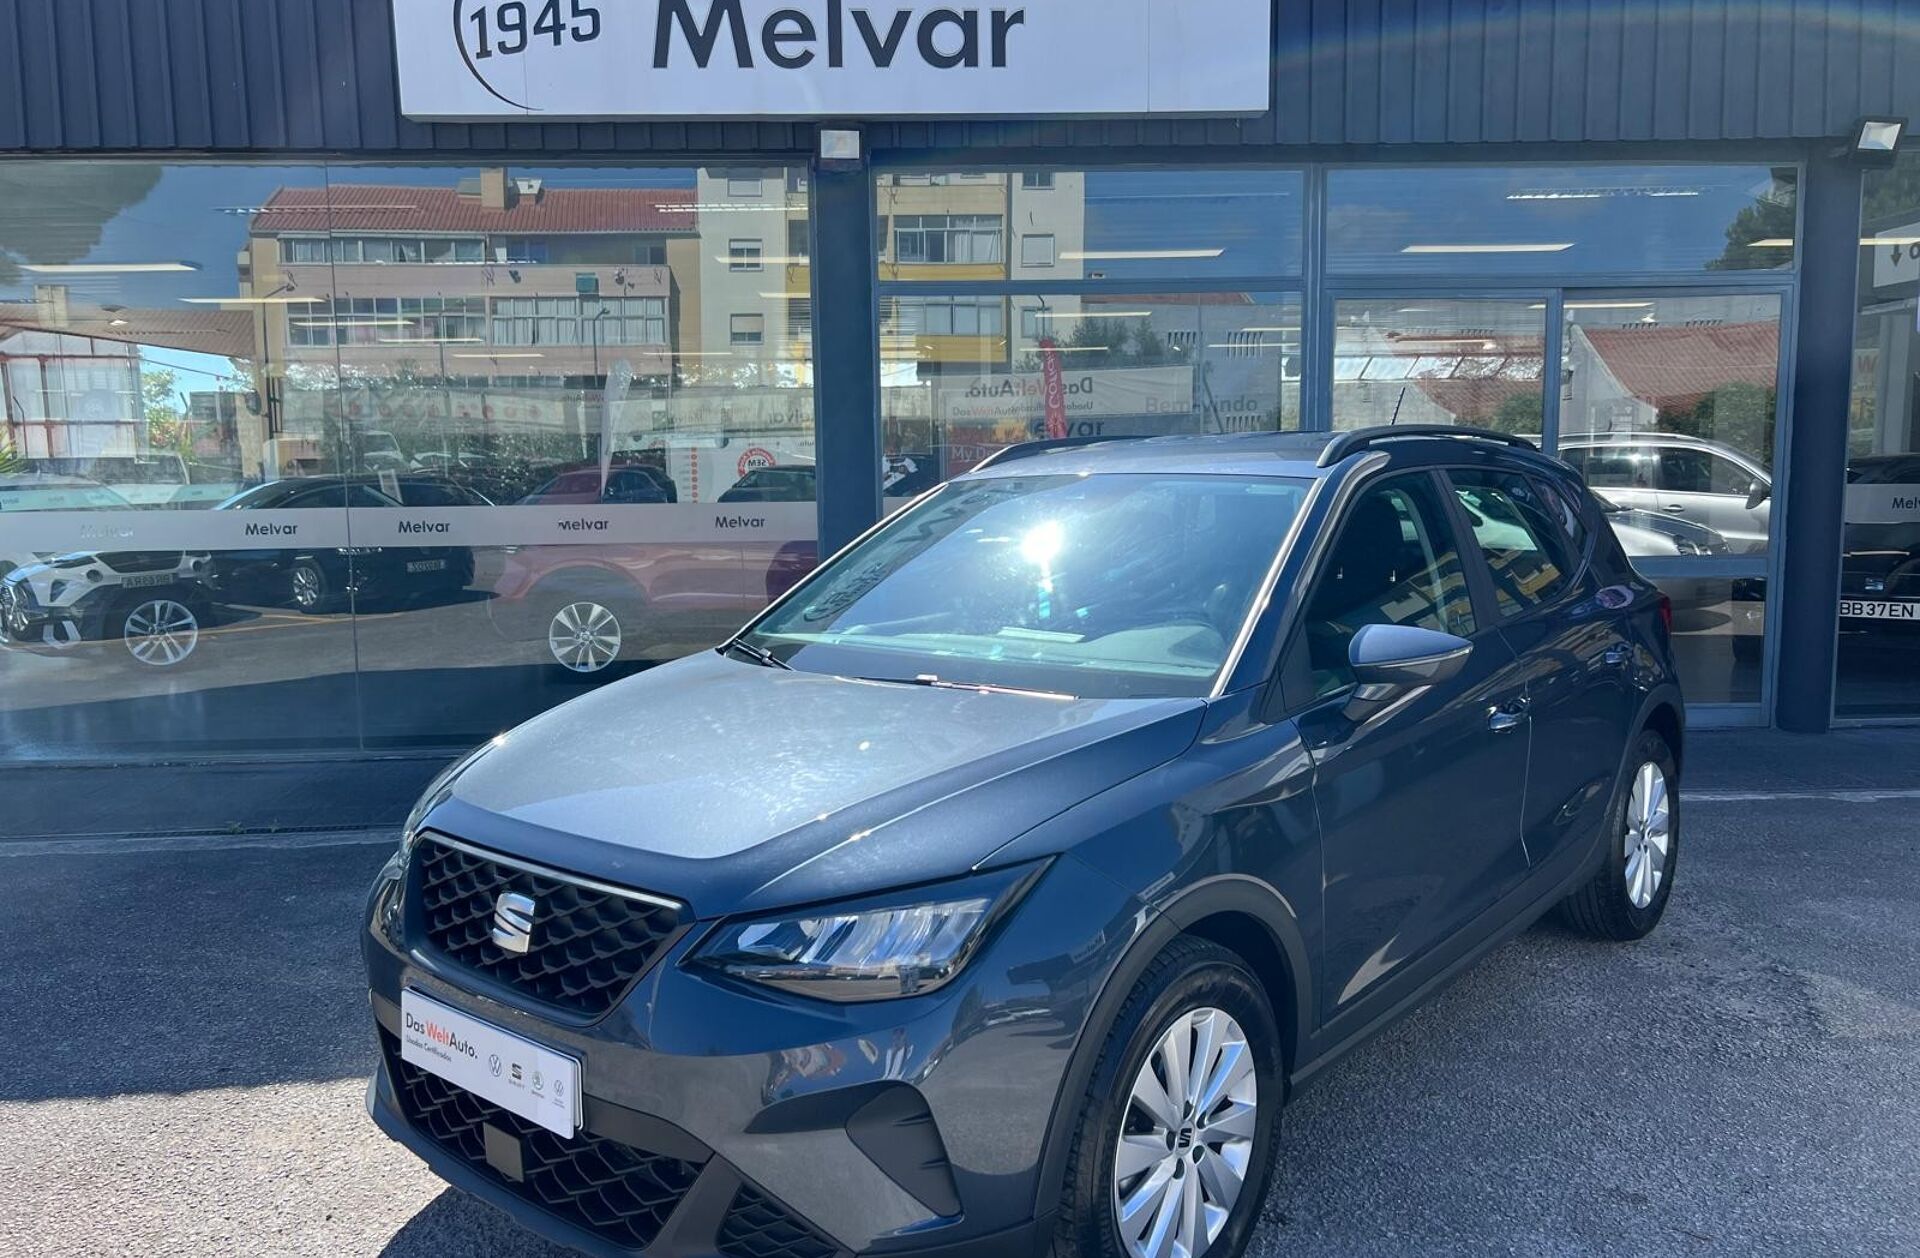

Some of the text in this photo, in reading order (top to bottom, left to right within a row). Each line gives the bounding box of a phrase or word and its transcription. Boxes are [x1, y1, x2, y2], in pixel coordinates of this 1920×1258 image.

[470, 0, 1025, 69] 1945 Melvar
[1892, 497, 1920, 509] Mel
[398, 521, 450, 533] Melvar
[558, 518, 608, 530] Melvar
[715, 516, 765, 528] Melvar
[245, 523, 298, 535] Melvar
